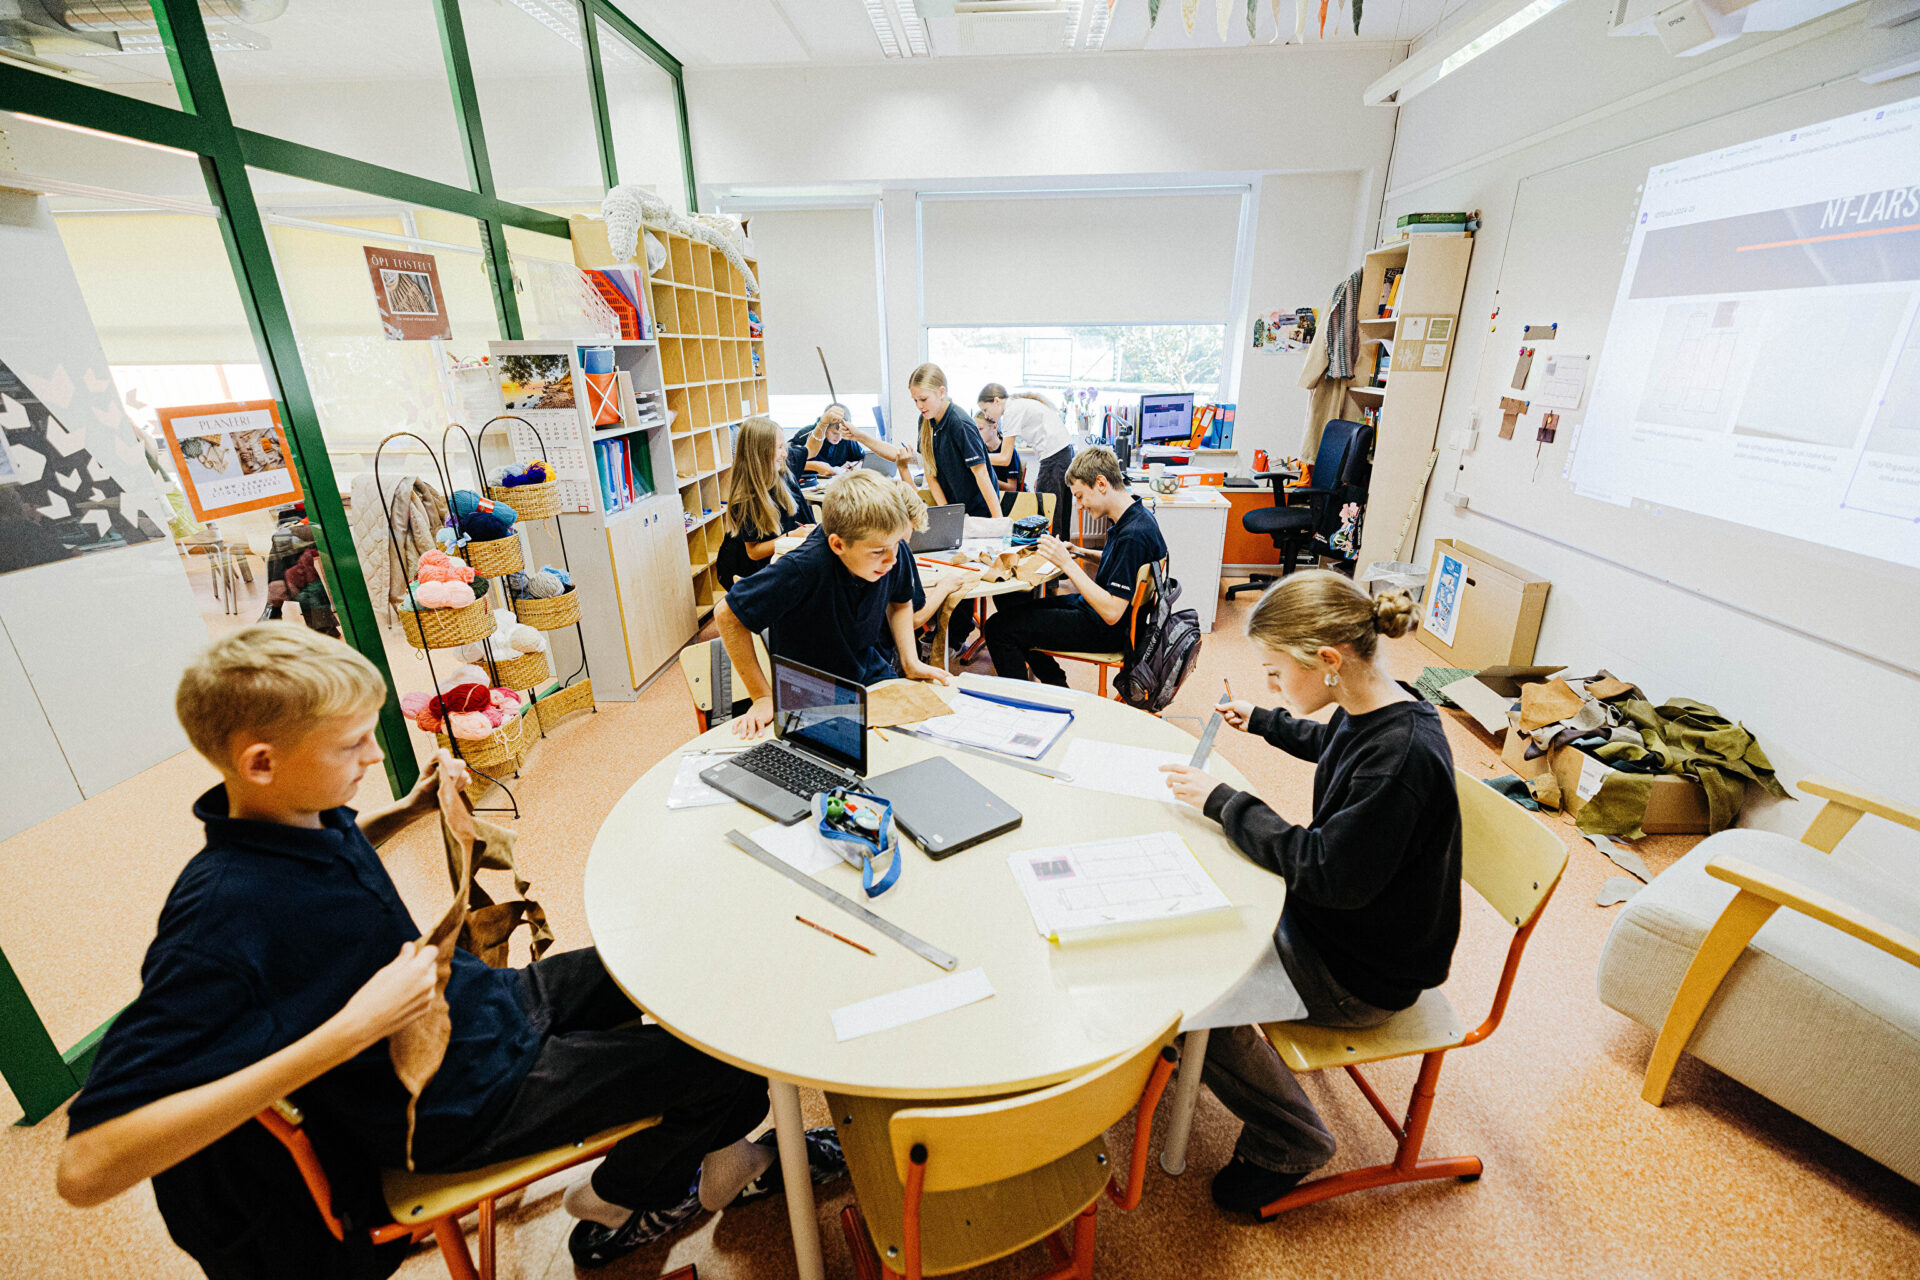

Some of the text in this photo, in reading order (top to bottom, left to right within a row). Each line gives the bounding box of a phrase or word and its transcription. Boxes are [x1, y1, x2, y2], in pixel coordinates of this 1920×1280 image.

[1668, 16, 1686, 27] EPSON
[1820, 186, 1920, 229] NT-LARS
[371, 254, 389, 267] ÕPI
